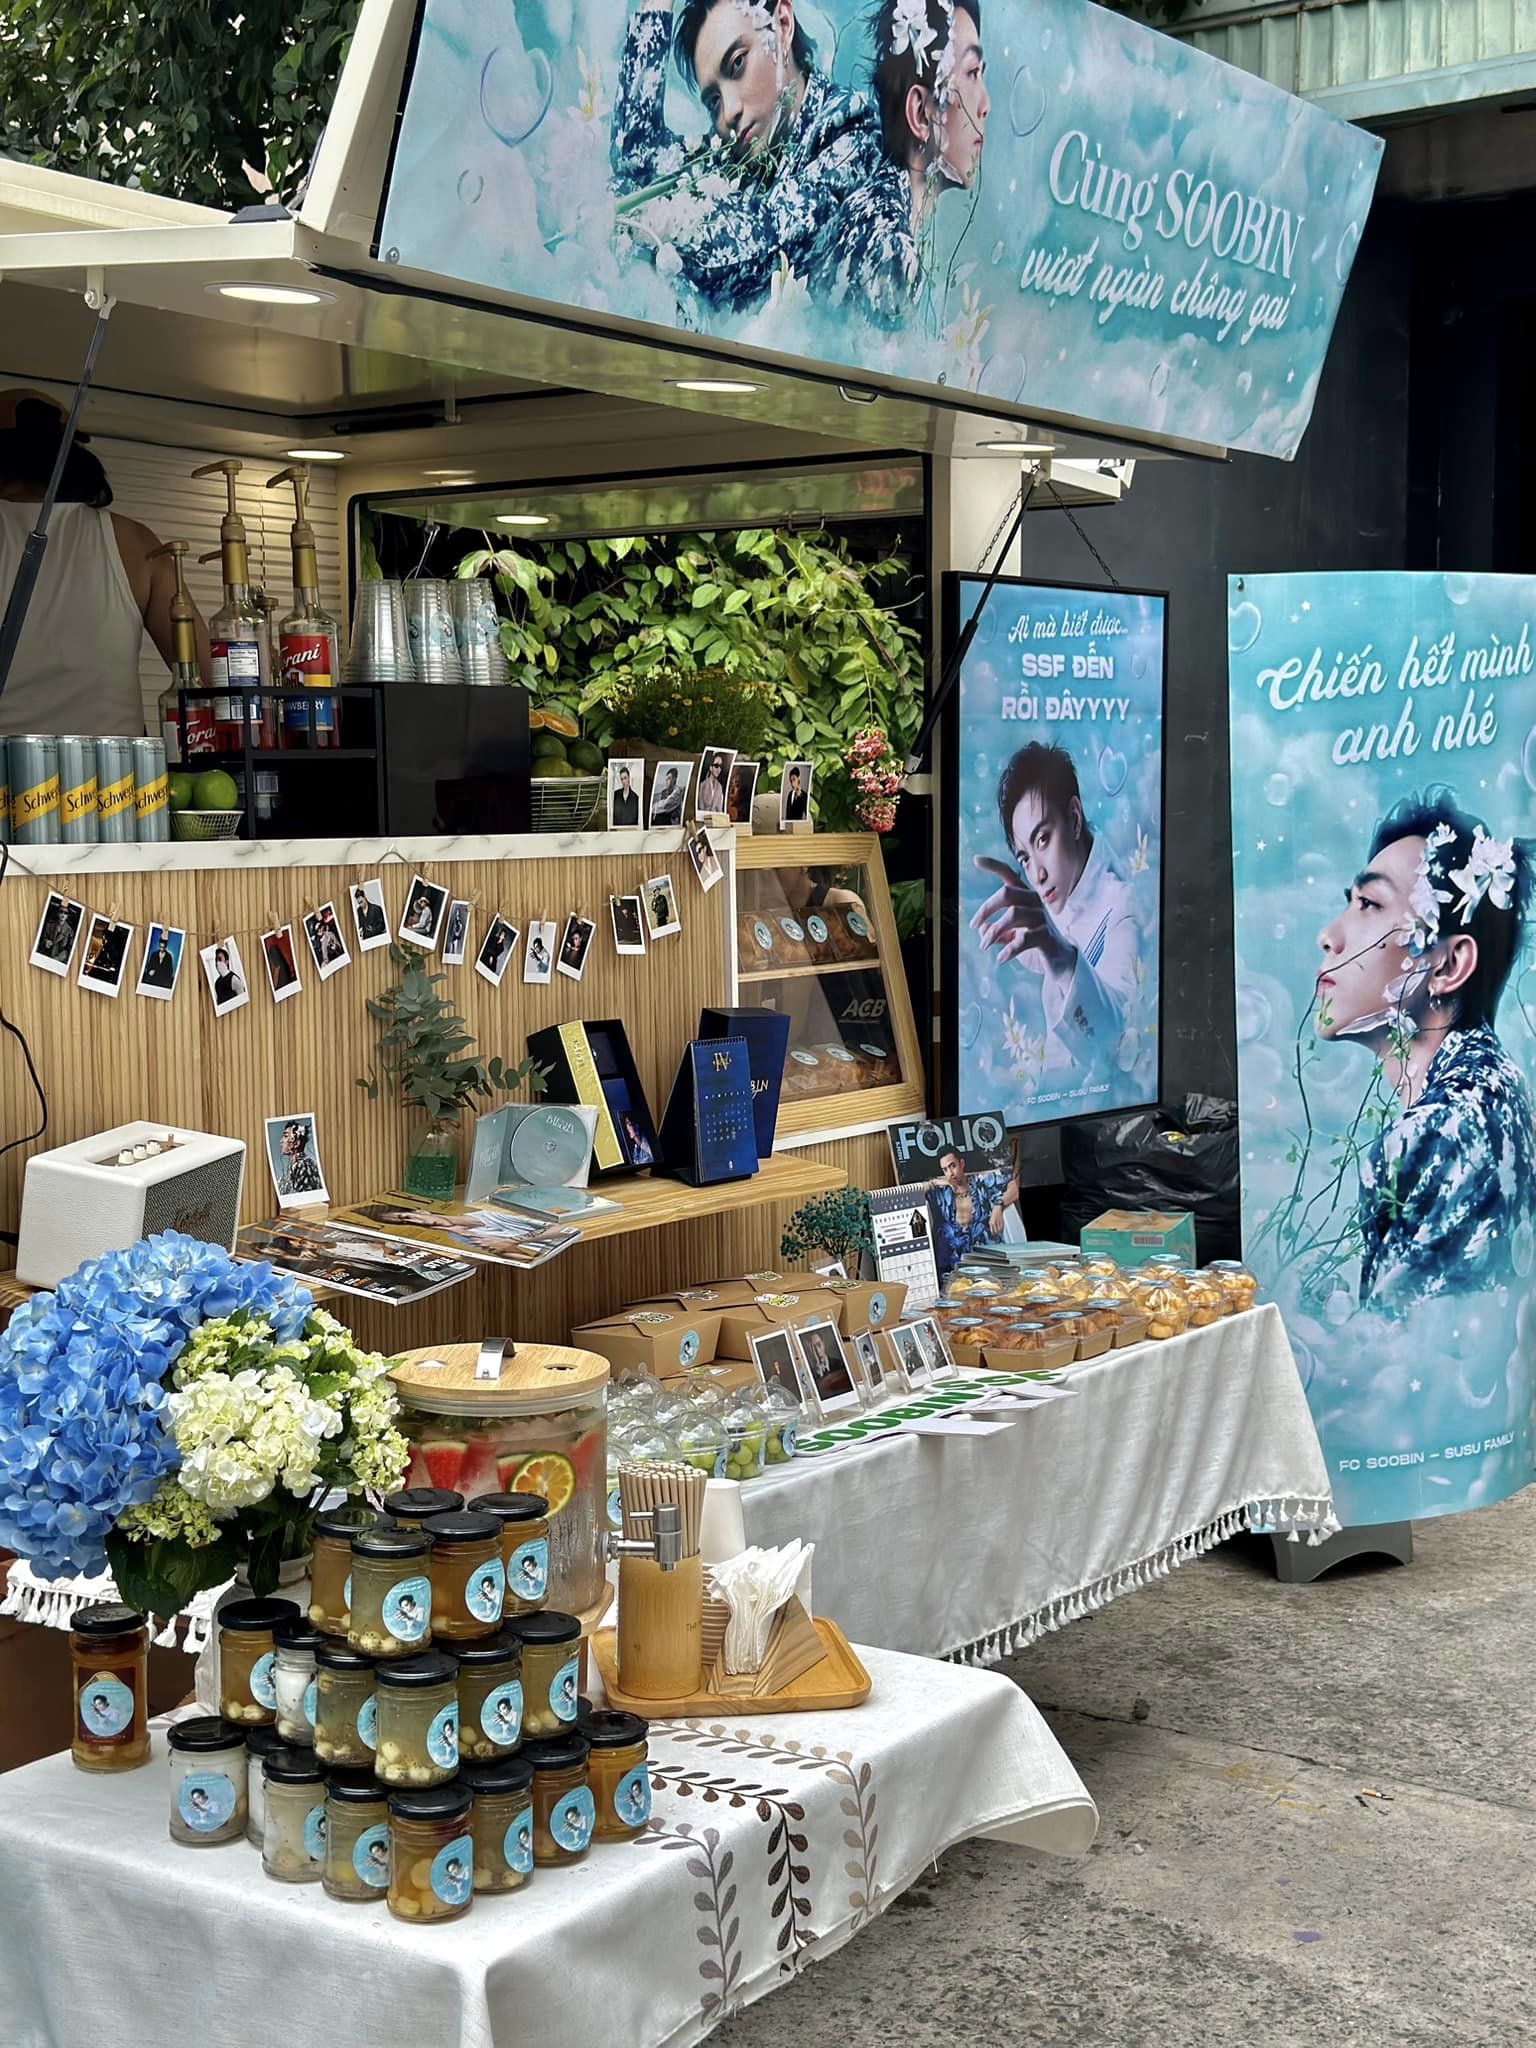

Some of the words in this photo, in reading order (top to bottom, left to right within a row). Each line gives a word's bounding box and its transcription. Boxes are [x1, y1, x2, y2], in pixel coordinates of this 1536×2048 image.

[1049, 129, 1158, 251] Cùng
[1155, 169, 1305, 279] SOOBIN
[1020, 236, 1099, 312] vượt
[1090, 254, 1165, 324] ngàn
[1170, 257, 1245, 342] chông
[1240, 283, 1296, 346] gai
[1008, 613, 1030, 643] Ai
[1033, 614, 1057, 639] mà
[1060, 608, 1089, 638] biết
[280, 643, 321, 667] rani
[1022, 653, 1065, 679] SSF
[1072, 640, 1115, 680] ĐẾN
[1256, 644, 1388, 711] Chiến
[1398, 631, 1457, 690] hết
[1460, 621, 1536, 683] mình
[1001, 681, 1039, 720] RỒI
[1045, 688, 1131, 721] ĐÂYYYY
[1331, 696, 1421, 766] anh
[1432, 688, 1498, 752] nhé
[898, 1116, 1003, 1160] FOLIO
[795, 1391, 985, 1452] SOOBIN
[1339, 1458, 1361, 1472] FC
[1366, 1452, 1425, 1469] SOOBIN
[1444, 1442, 1481, 1460] SUSU
[1483, 1431, 1515, 1453] FAMILY
